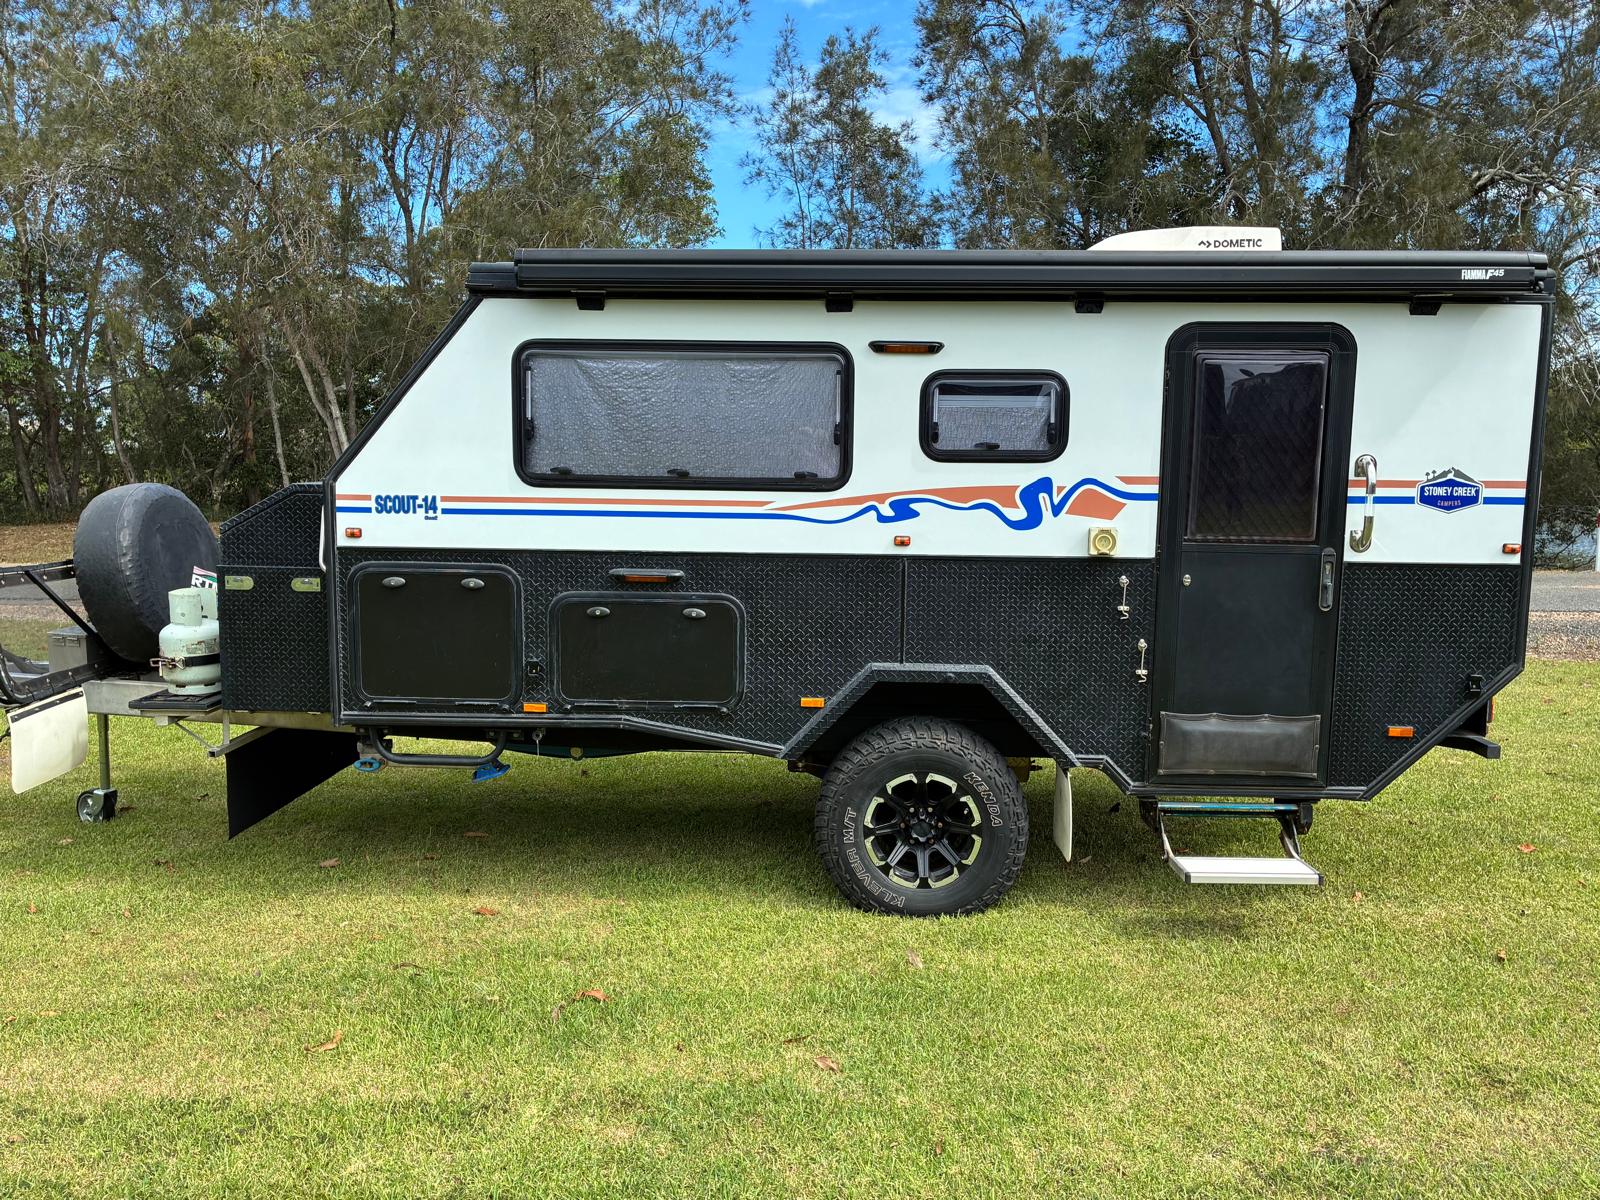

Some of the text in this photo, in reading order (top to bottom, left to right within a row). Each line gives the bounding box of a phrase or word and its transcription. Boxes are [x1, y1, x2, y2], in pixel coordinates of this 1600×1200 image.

[1213, 238, 1262, 248] DOMETIC
[1424, 486, 1476, 497] STONEY CREEK
[374, 494, 438, 514] SCOUT-14
[1437, 499, 1461, 507] CAMPERS
[962, 771, 1003, 827] KENDA
[843, 806, 906, 908] KLEVER M/T
